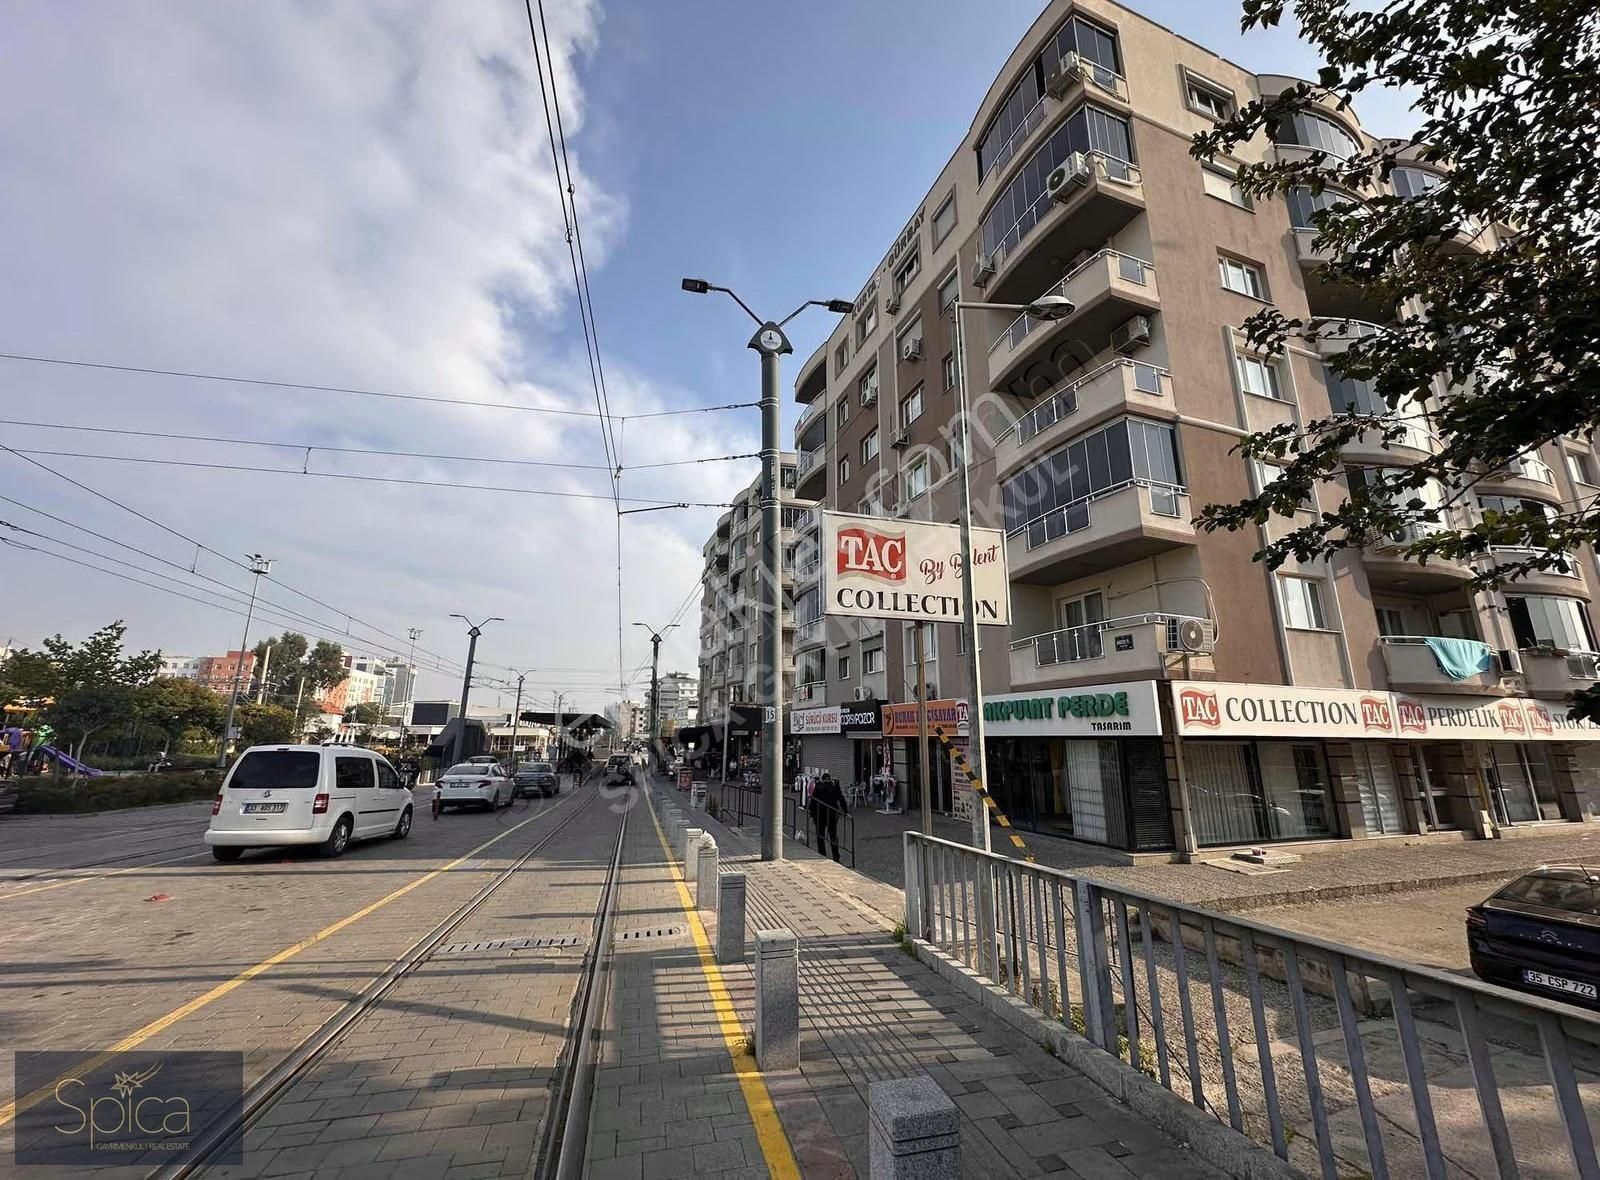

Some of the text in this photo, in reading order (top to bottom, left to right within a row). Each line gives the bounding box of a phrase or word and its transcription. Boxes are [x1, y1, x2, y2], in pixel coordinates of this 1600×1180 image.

[920, 545, 1000, 585] By Blent
[767, 710, 775, 720] 15
[957, 704, 968, 720] TA
[1058, 692, 1129, 719] PERDE
[1225, 697, 1358, 725] COLLECTION
[1091, 722, 1131, 731] TASARIM
[1529, 972, 1593, 995] 35 CSP 722
